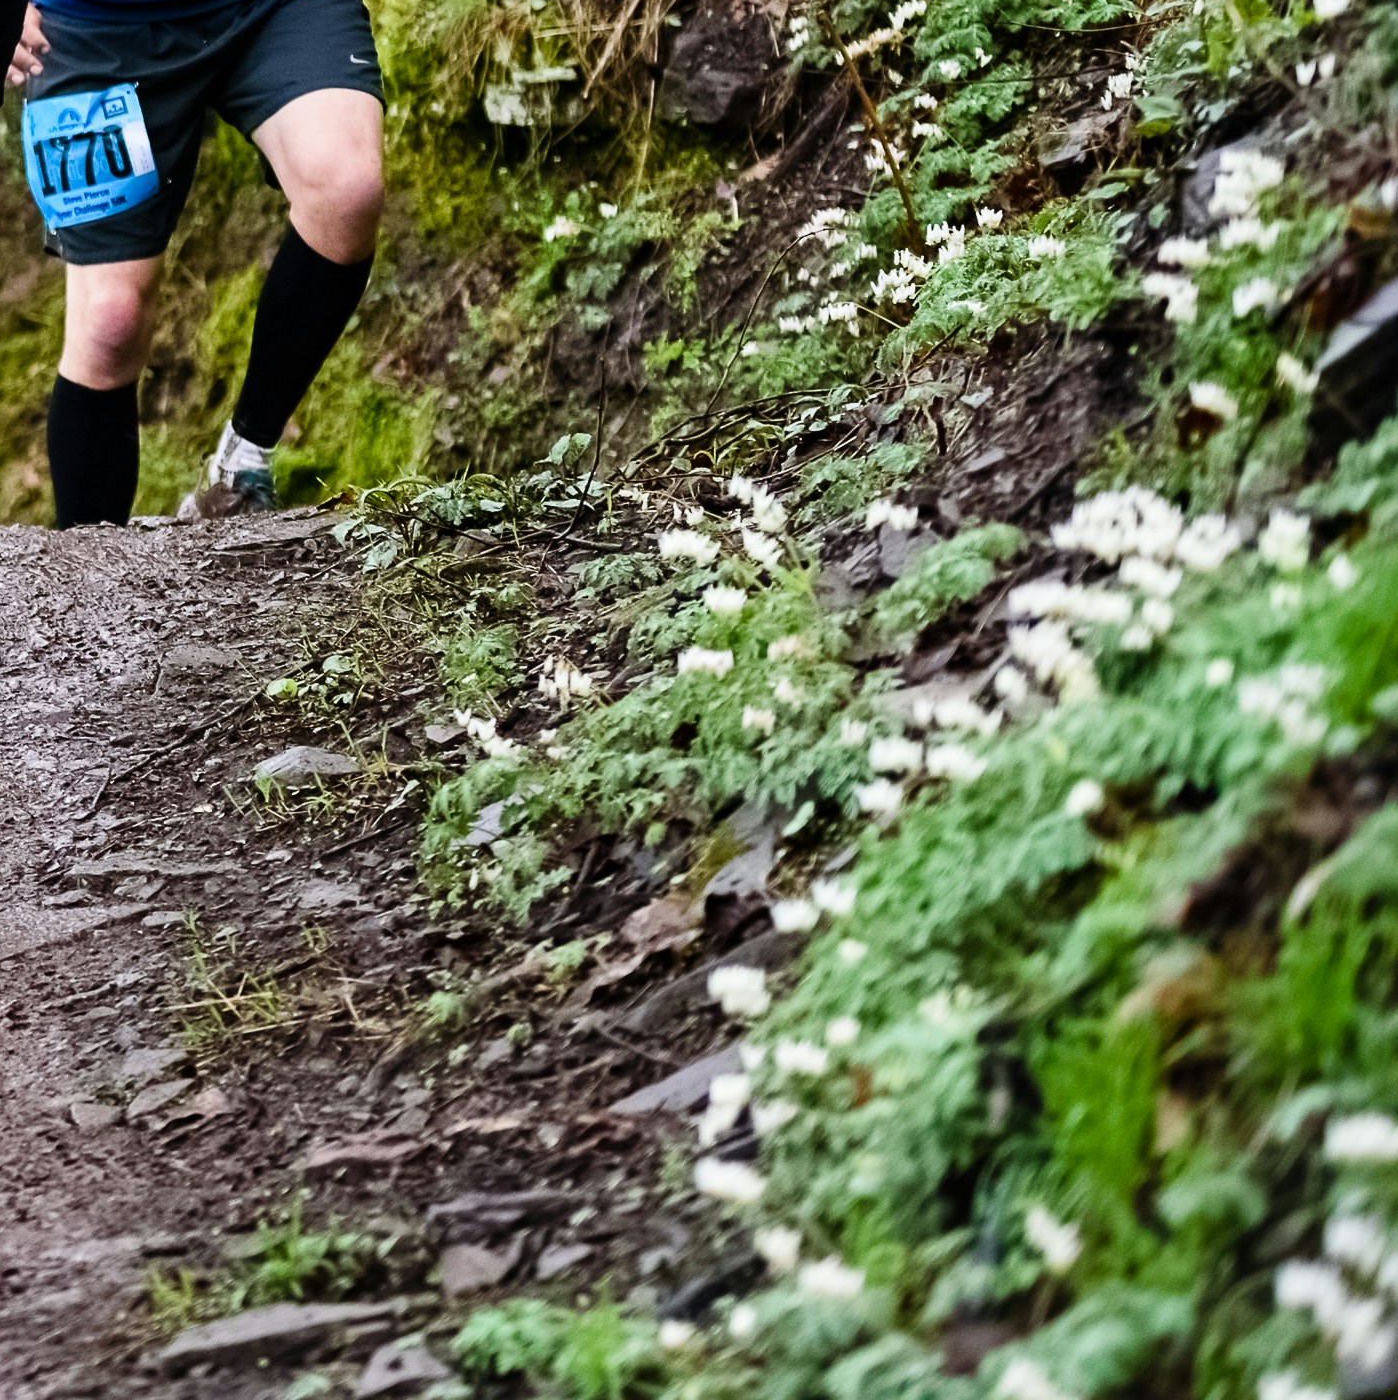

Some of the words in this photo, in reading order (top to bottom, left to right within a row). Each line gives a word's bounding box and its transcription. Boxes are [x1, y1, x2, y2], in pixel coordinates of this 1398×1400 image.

[33, 124, 133, 197] 1770
[84, 189, 110, 200] Pierce
[74, 201, 111, 217] Challenge
